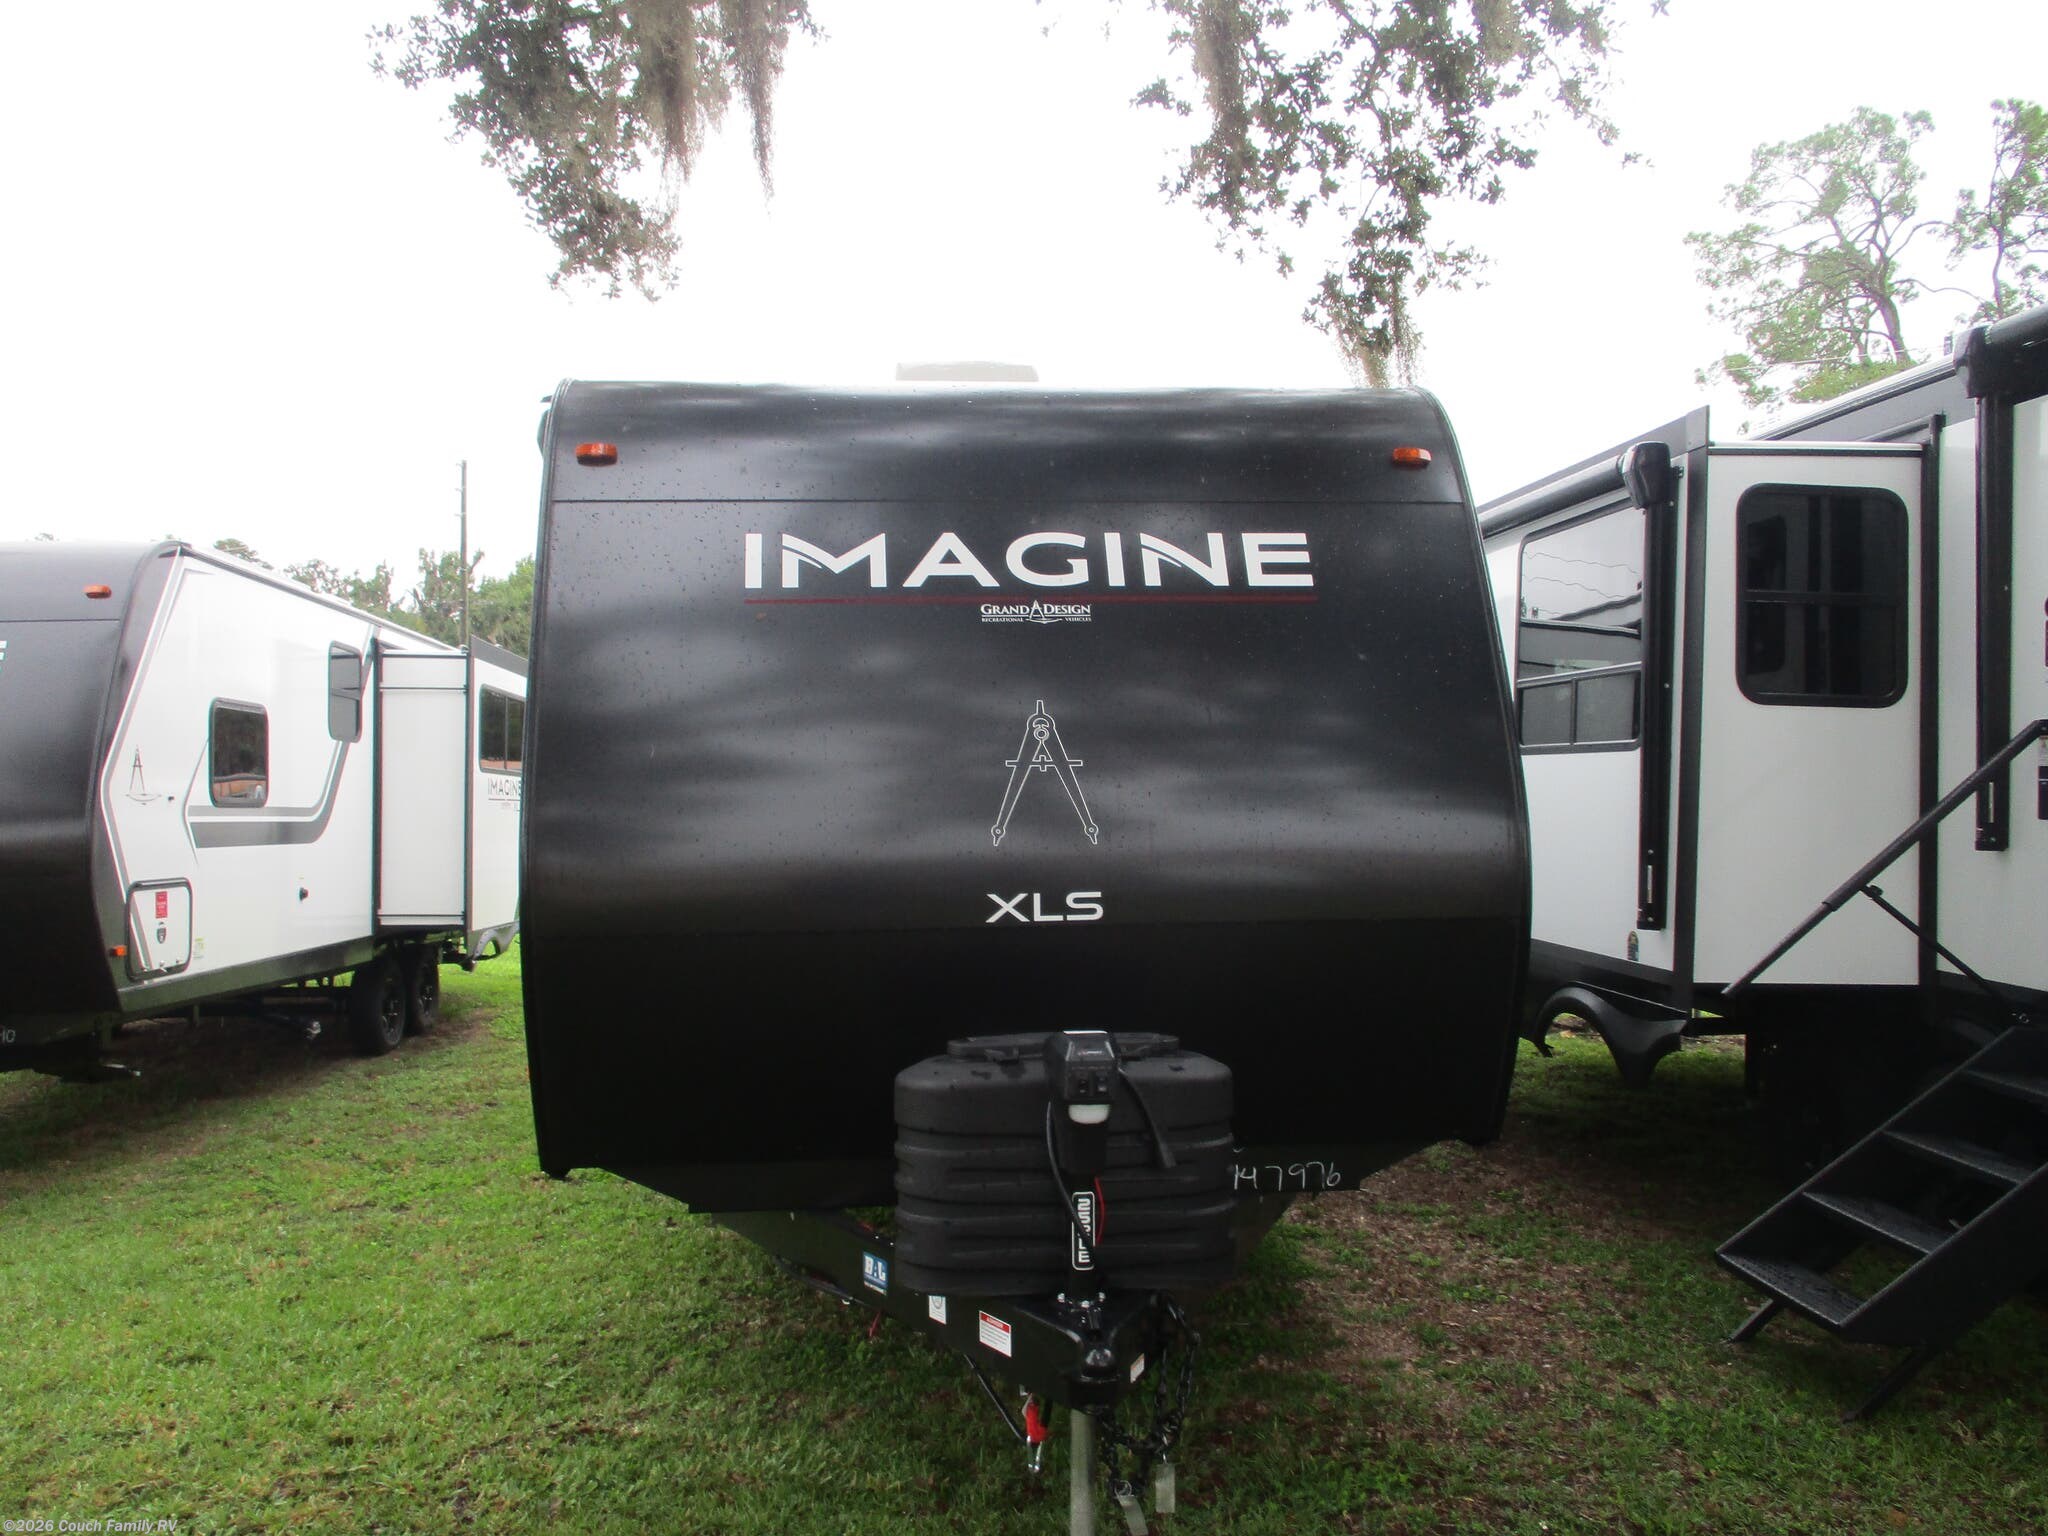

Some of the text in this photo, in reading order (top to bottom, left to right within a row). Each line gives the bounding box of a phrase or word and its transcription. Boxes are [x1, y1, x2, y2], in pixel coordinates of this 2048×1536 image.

[744, 531, 1315, 589] IMAGINE
[980, 603, 1091, 615] GRAND DESIGN
[985, 891, 1104, 923] XLS
